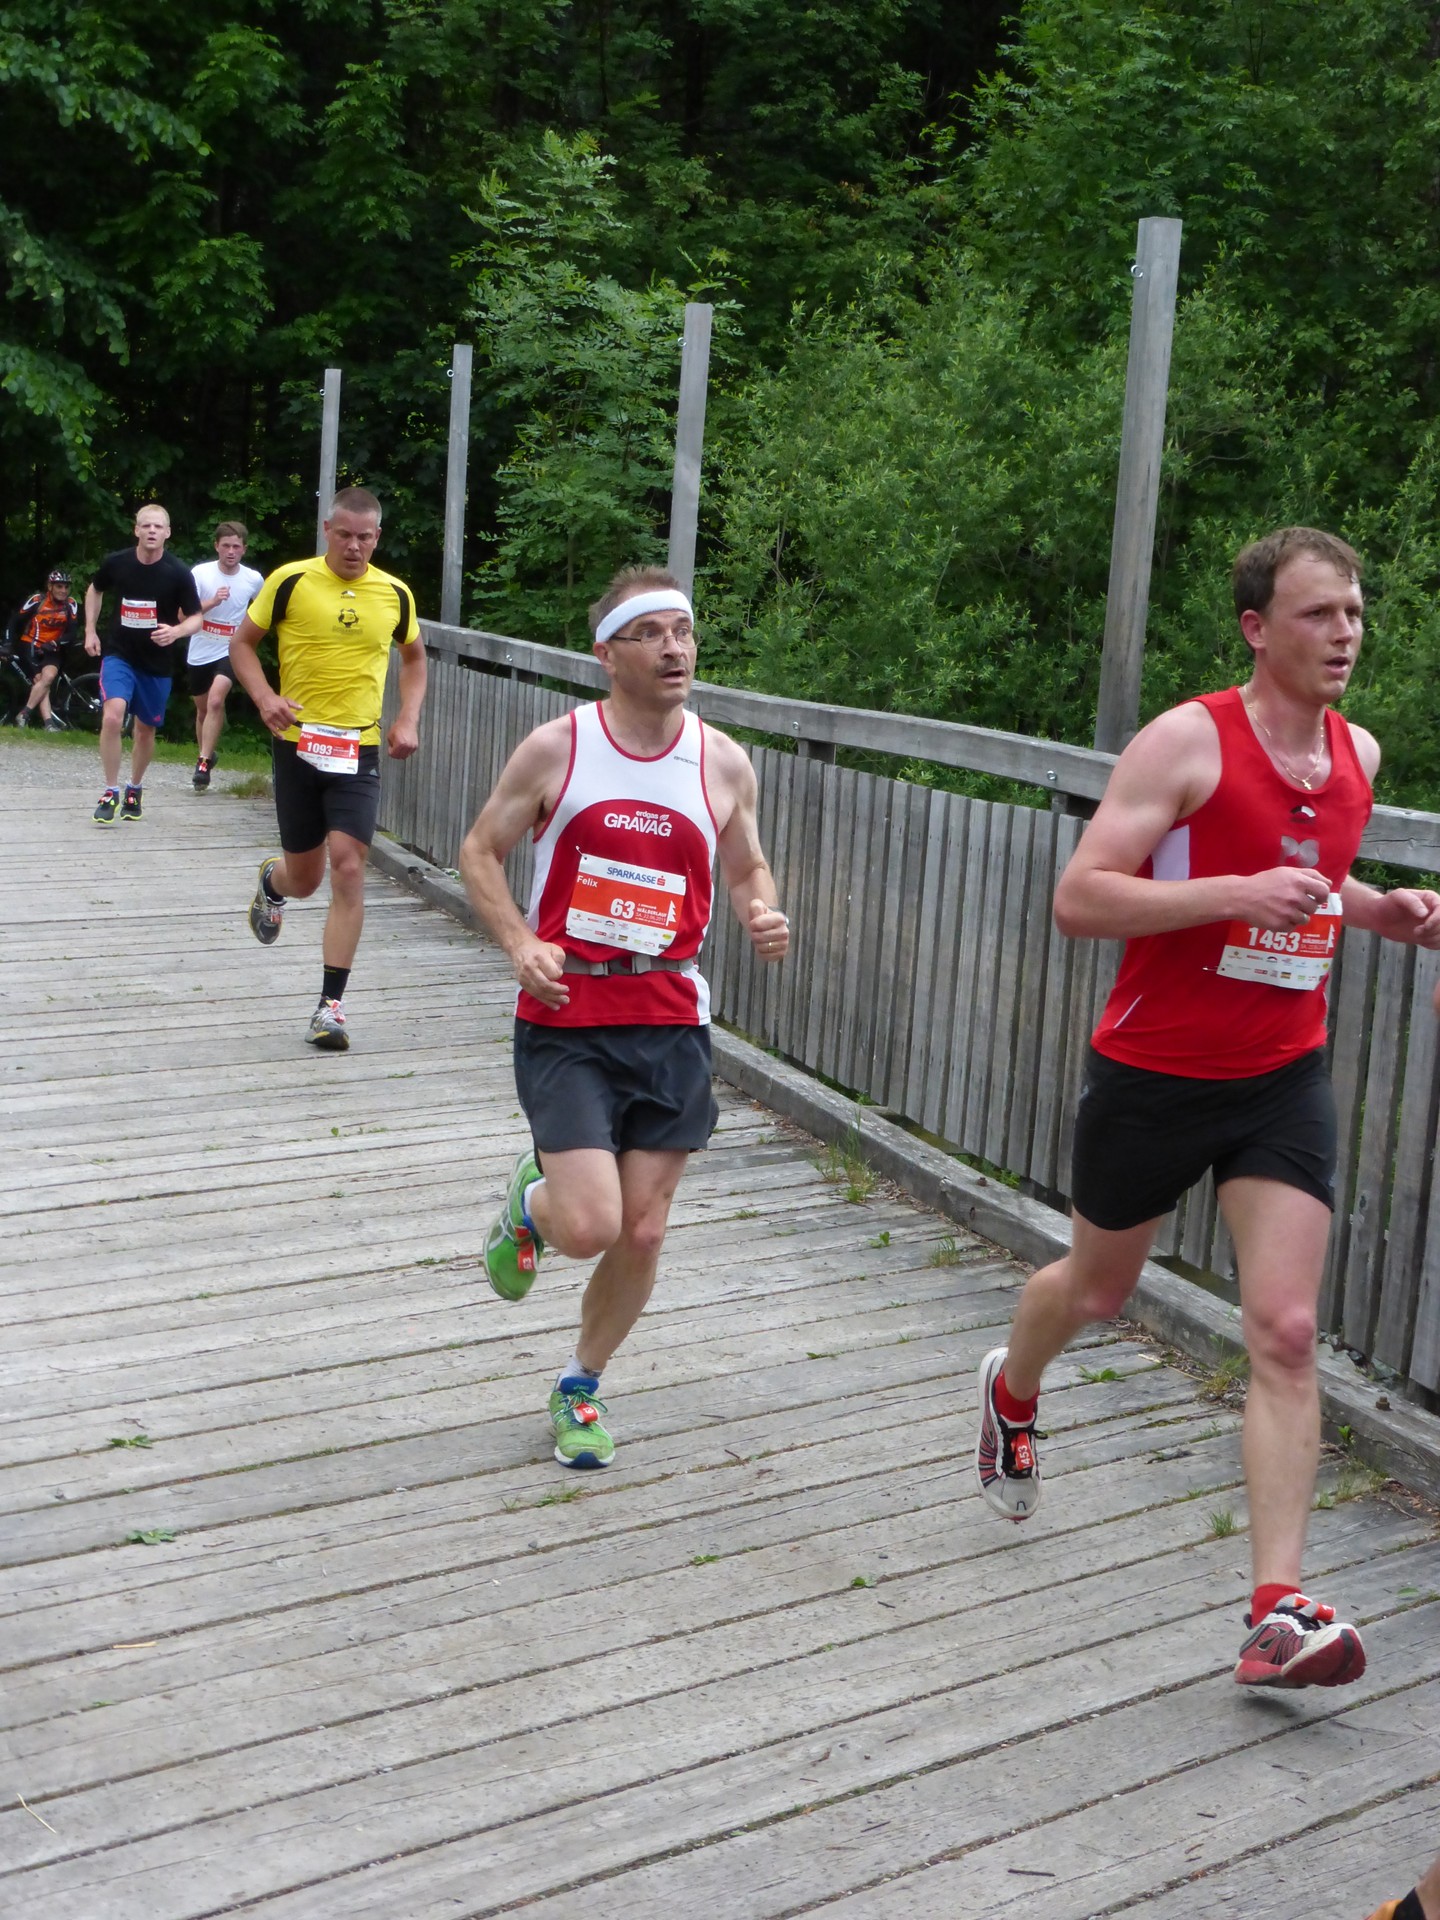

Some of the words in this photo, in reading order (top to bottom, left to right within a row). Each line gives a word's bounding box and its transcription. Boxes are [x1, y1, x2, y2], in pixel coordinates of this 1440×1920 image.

[307, 741, 333, 756] 1093
[635, 810, 659, 820] erdgas
[604, 812, 673, 838] GRAVAG
[576, 874, 598, 888] Felix
[606, 866, 657, 885] SPARKASSE
[610, 898, 636, 919] 63
[1248, 926, 1301, 953] 1453
